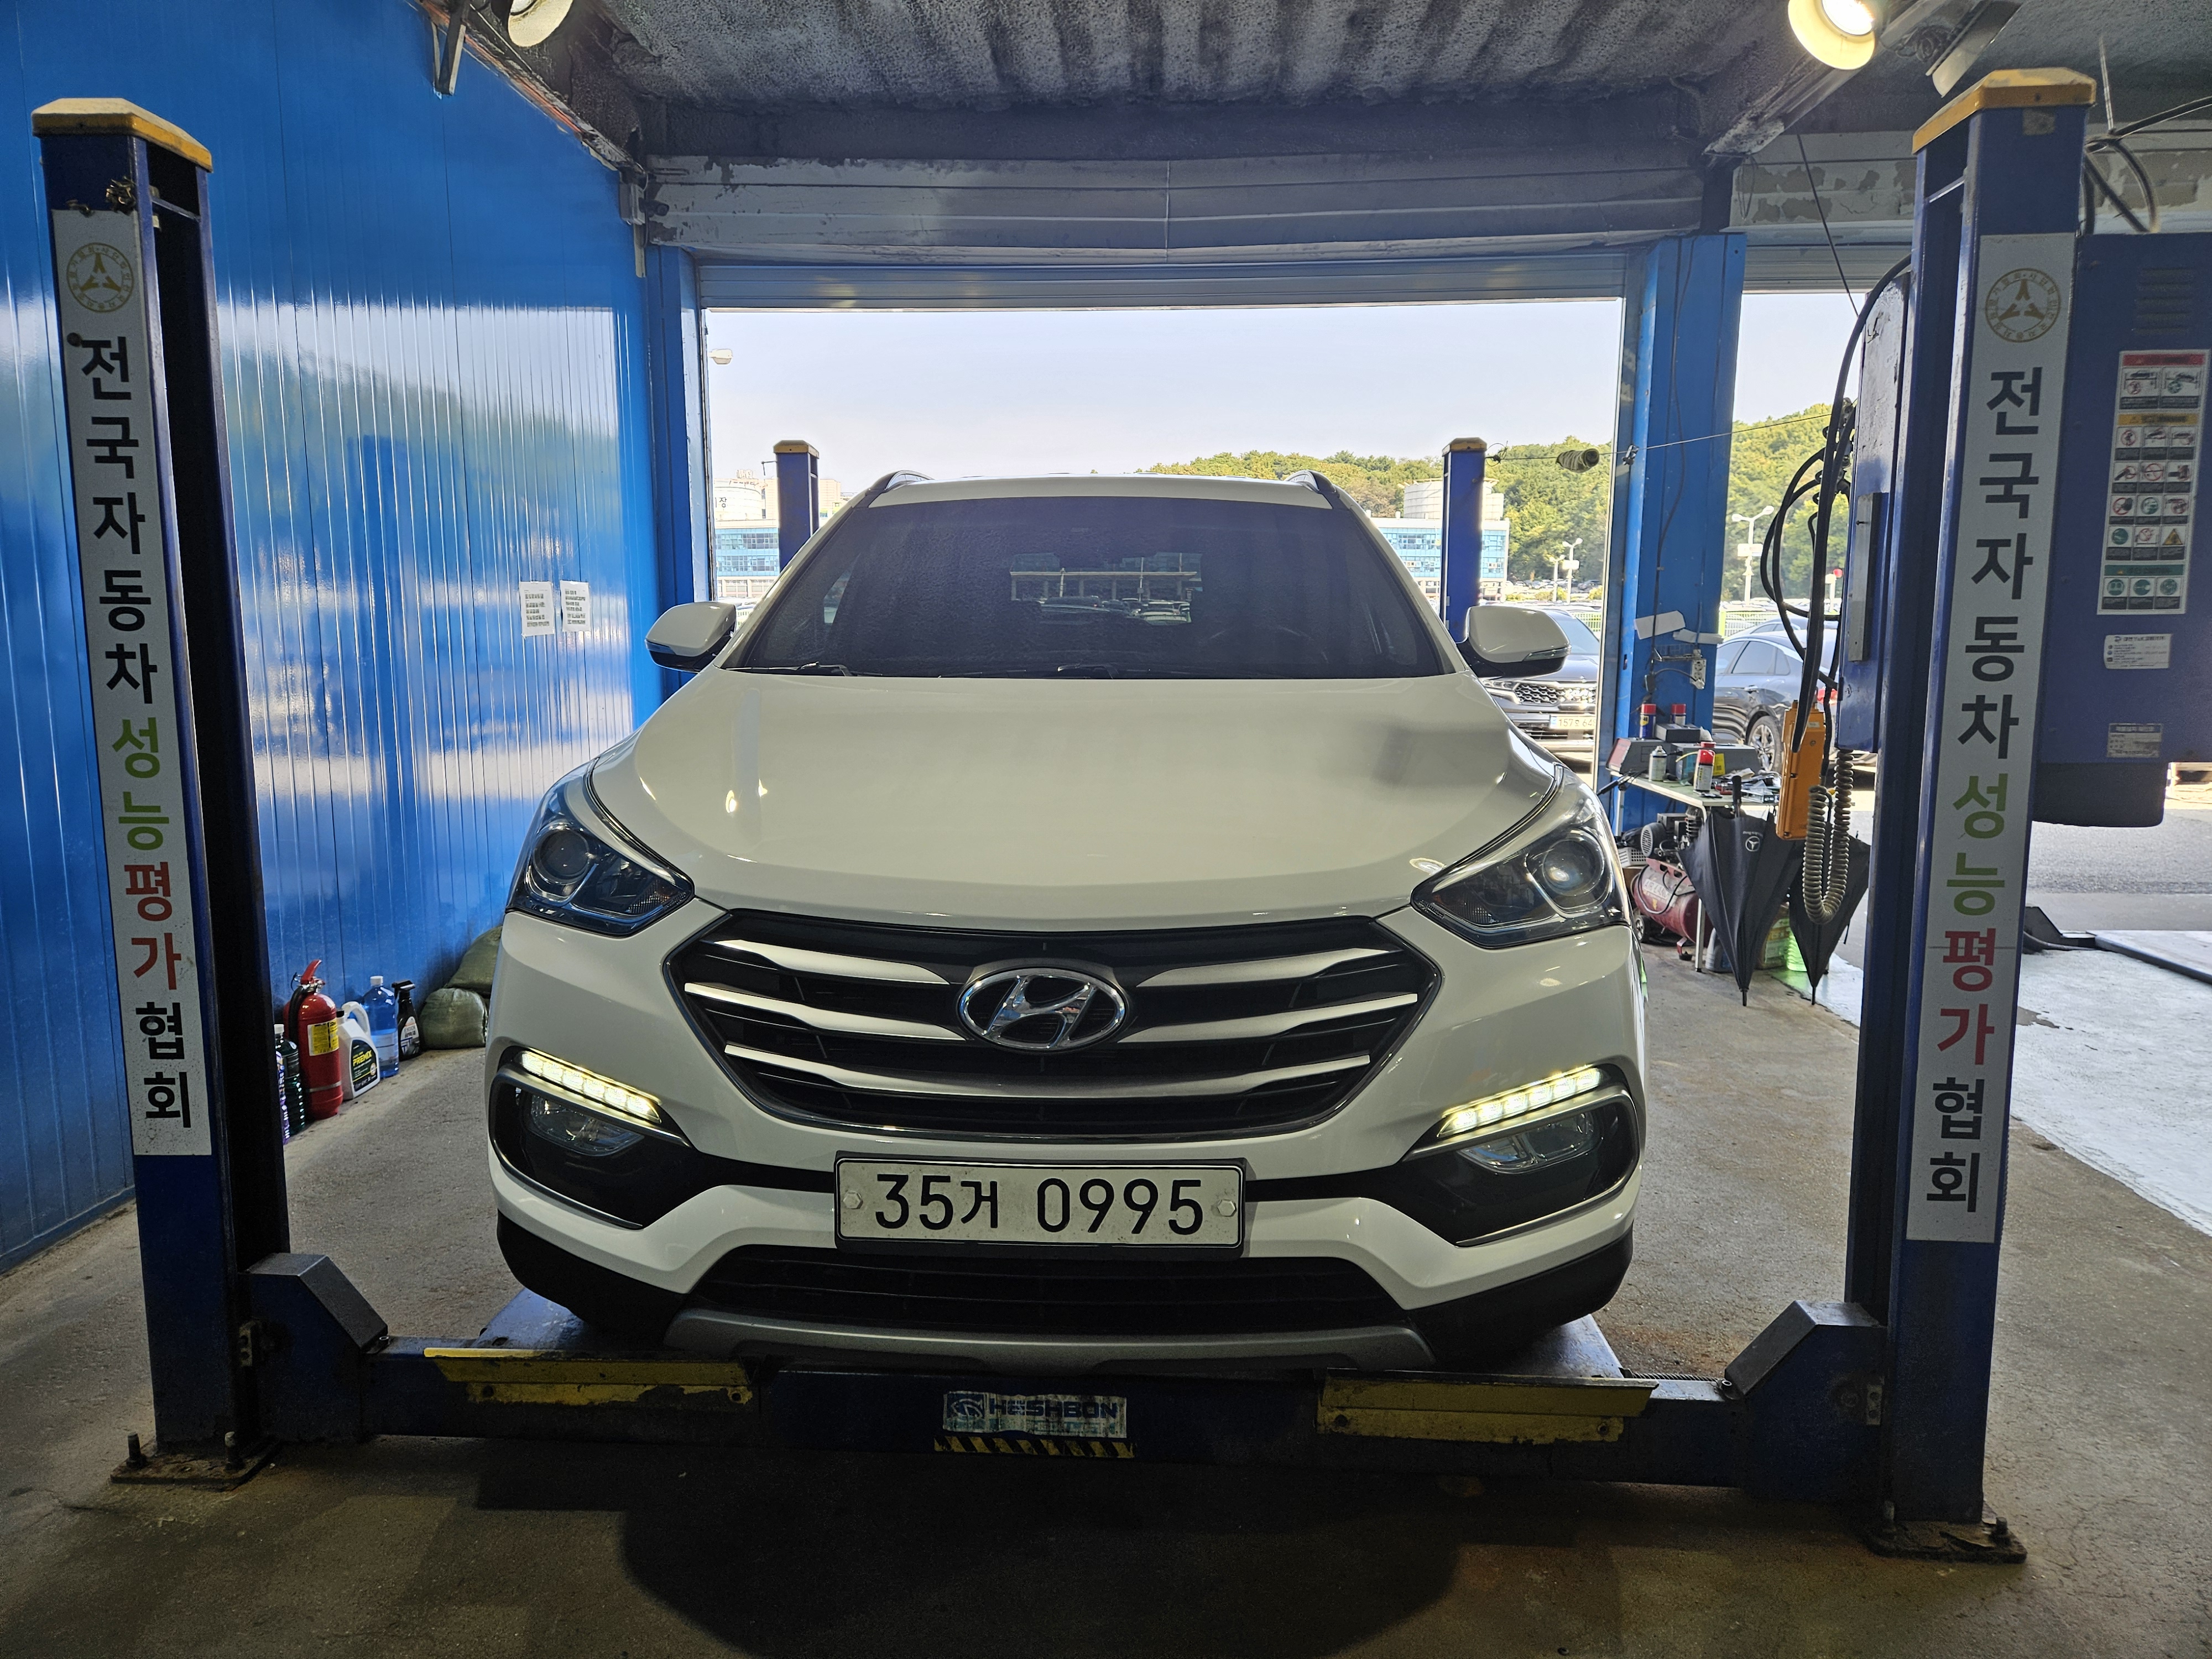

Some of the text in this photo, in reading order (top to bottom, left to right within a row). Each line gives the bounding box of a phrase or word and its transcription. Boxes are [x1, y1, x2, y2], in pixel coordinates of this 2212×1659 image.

[81, 335, 191, 1128] 전국자동차성능평가협회
[1927, 367, 2042, 1213] 전국자동차성능평가협회
[353, 1050, 372, 1067] PREMIX
[875, 1173, 1204, 1235] 35거 0995
[989, 1397, 1119, 1419] HESHBON
